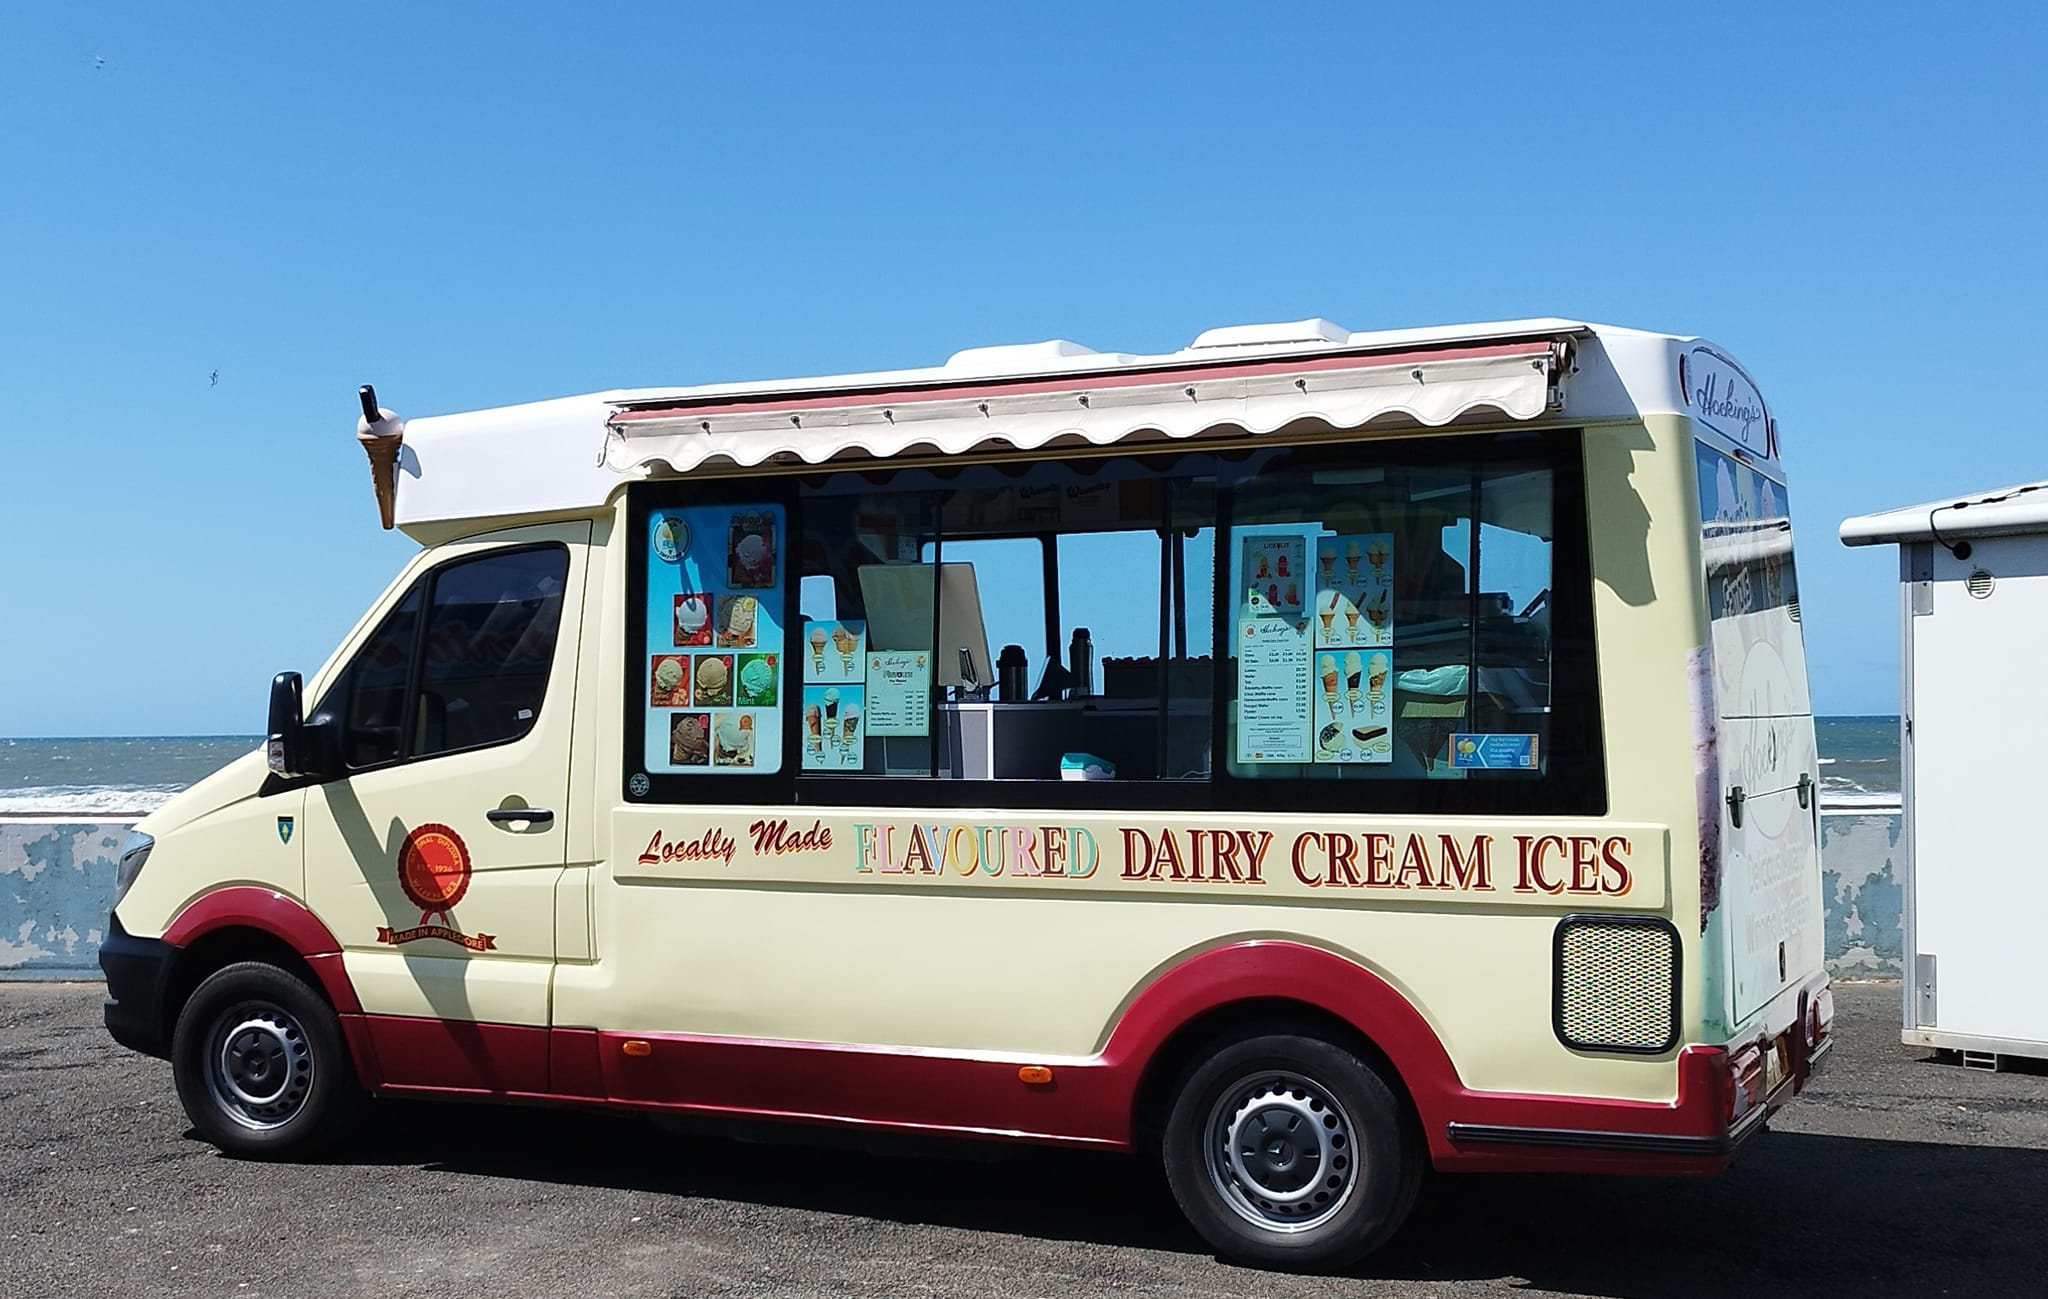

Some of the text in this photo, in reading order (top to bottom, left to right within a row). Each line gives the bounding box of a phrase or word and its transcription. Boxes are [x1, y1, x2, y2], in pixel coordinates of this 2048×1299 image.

[1697, 372, 1761, 442] Hocking's
[638, 819, 1633, 896] Locally Made FLAVOURED DAIRY CREAM ICES
[390, 928, 484, 948] MADE IN APPLEDORE
